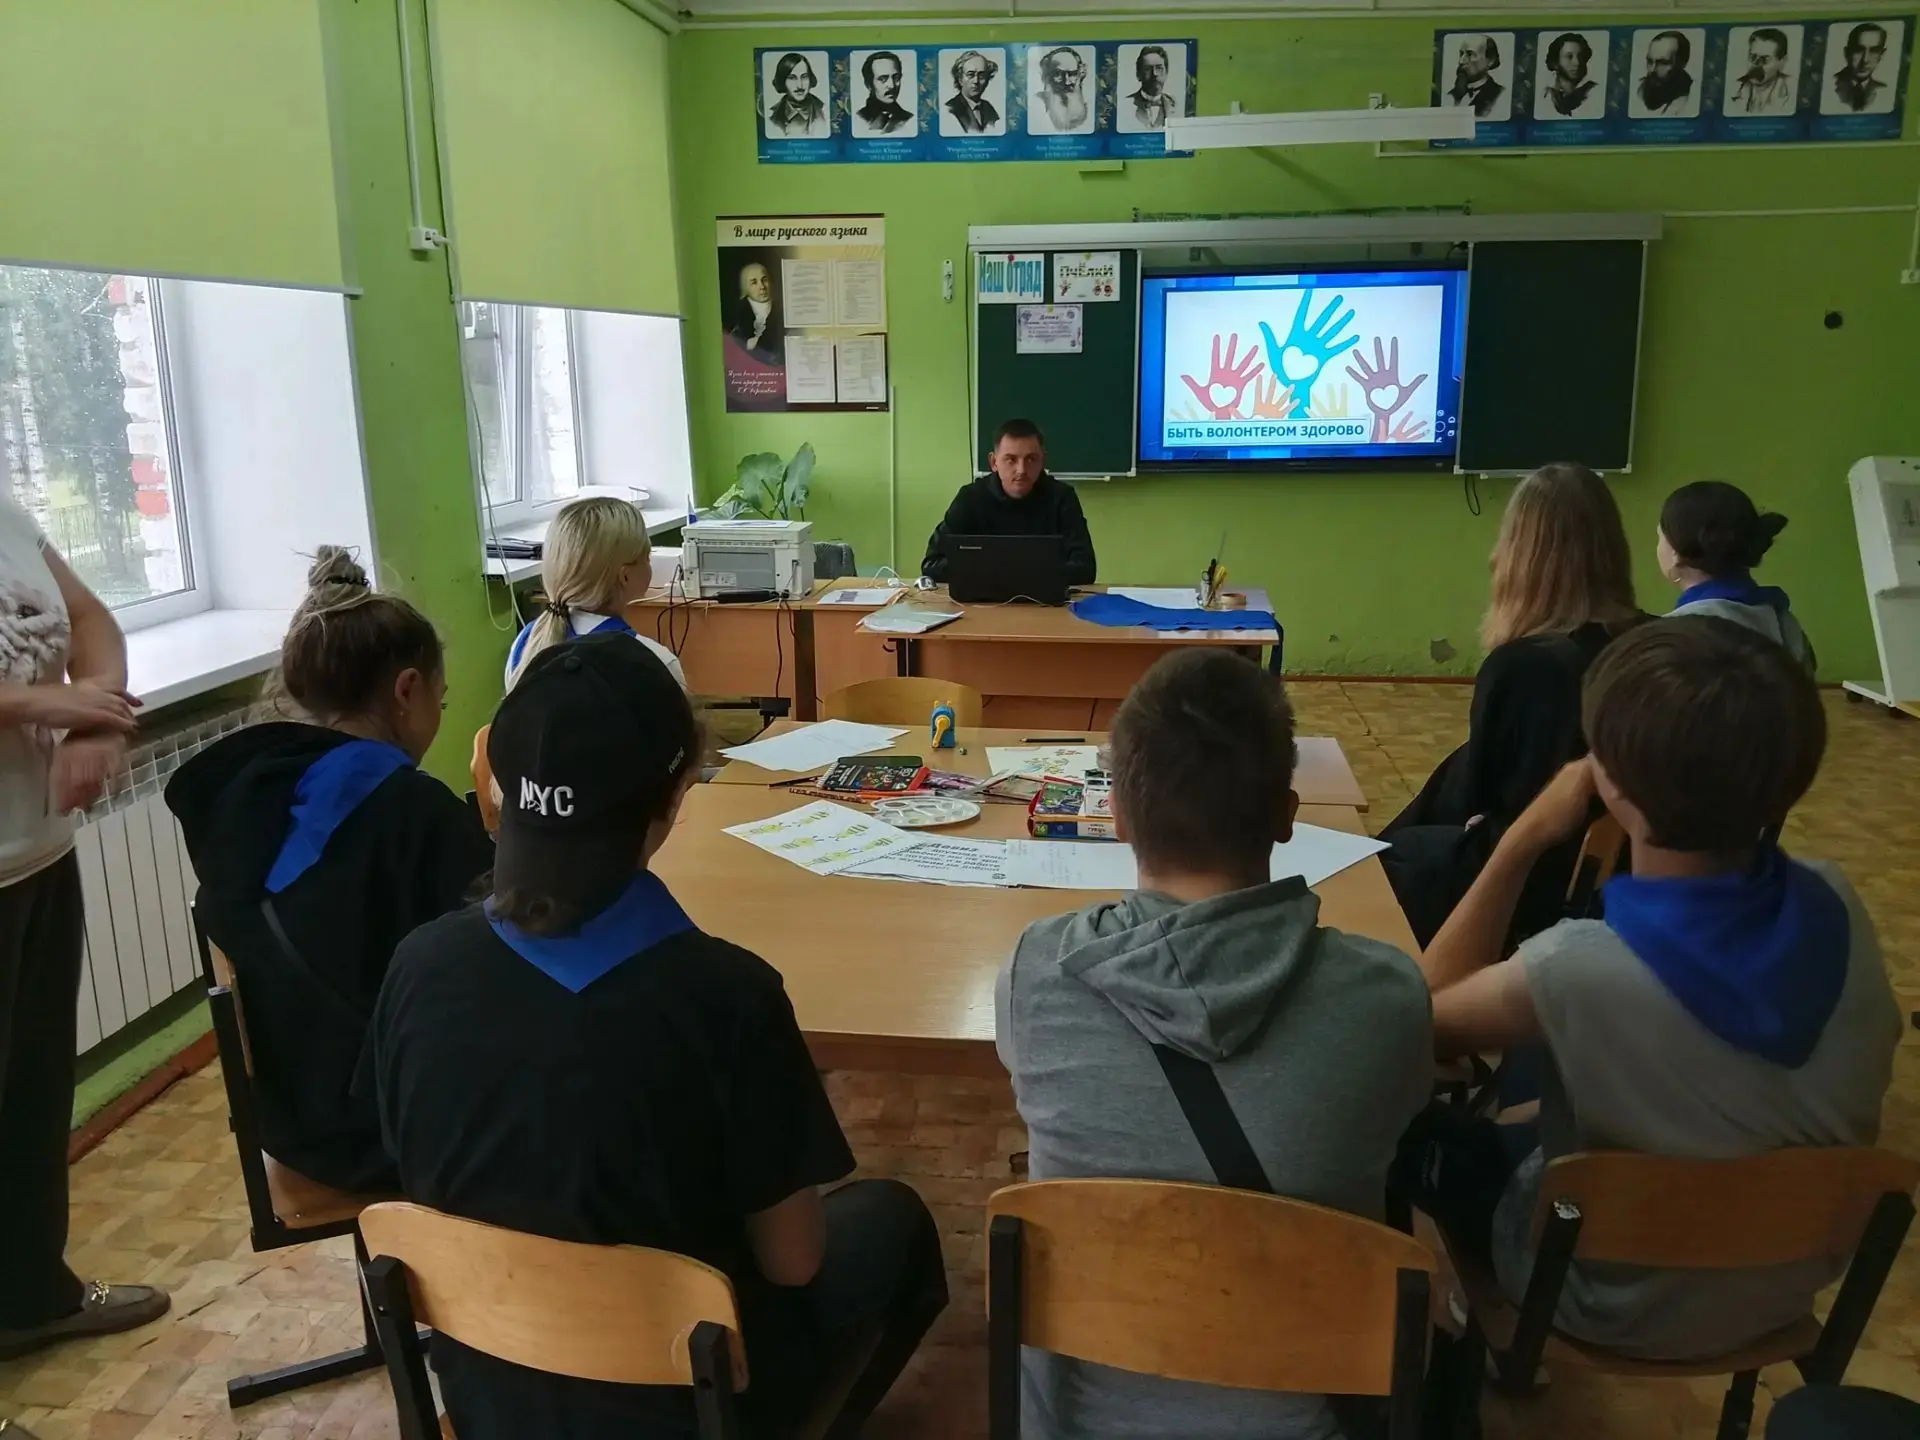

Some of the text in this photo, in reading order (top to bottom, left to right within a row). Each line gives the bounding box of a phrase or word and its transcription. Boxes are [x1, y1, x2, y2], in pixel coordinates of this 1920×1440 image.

[733, 225, 868, 241] В мире русского языка
[979, 255, 1004, 293] Наш
[1167, 424, 1365, 439] БЫТЬ ВОЛОНТЕРОМ ЗДОРОВО
[519, 776, 574, 817] NYC
